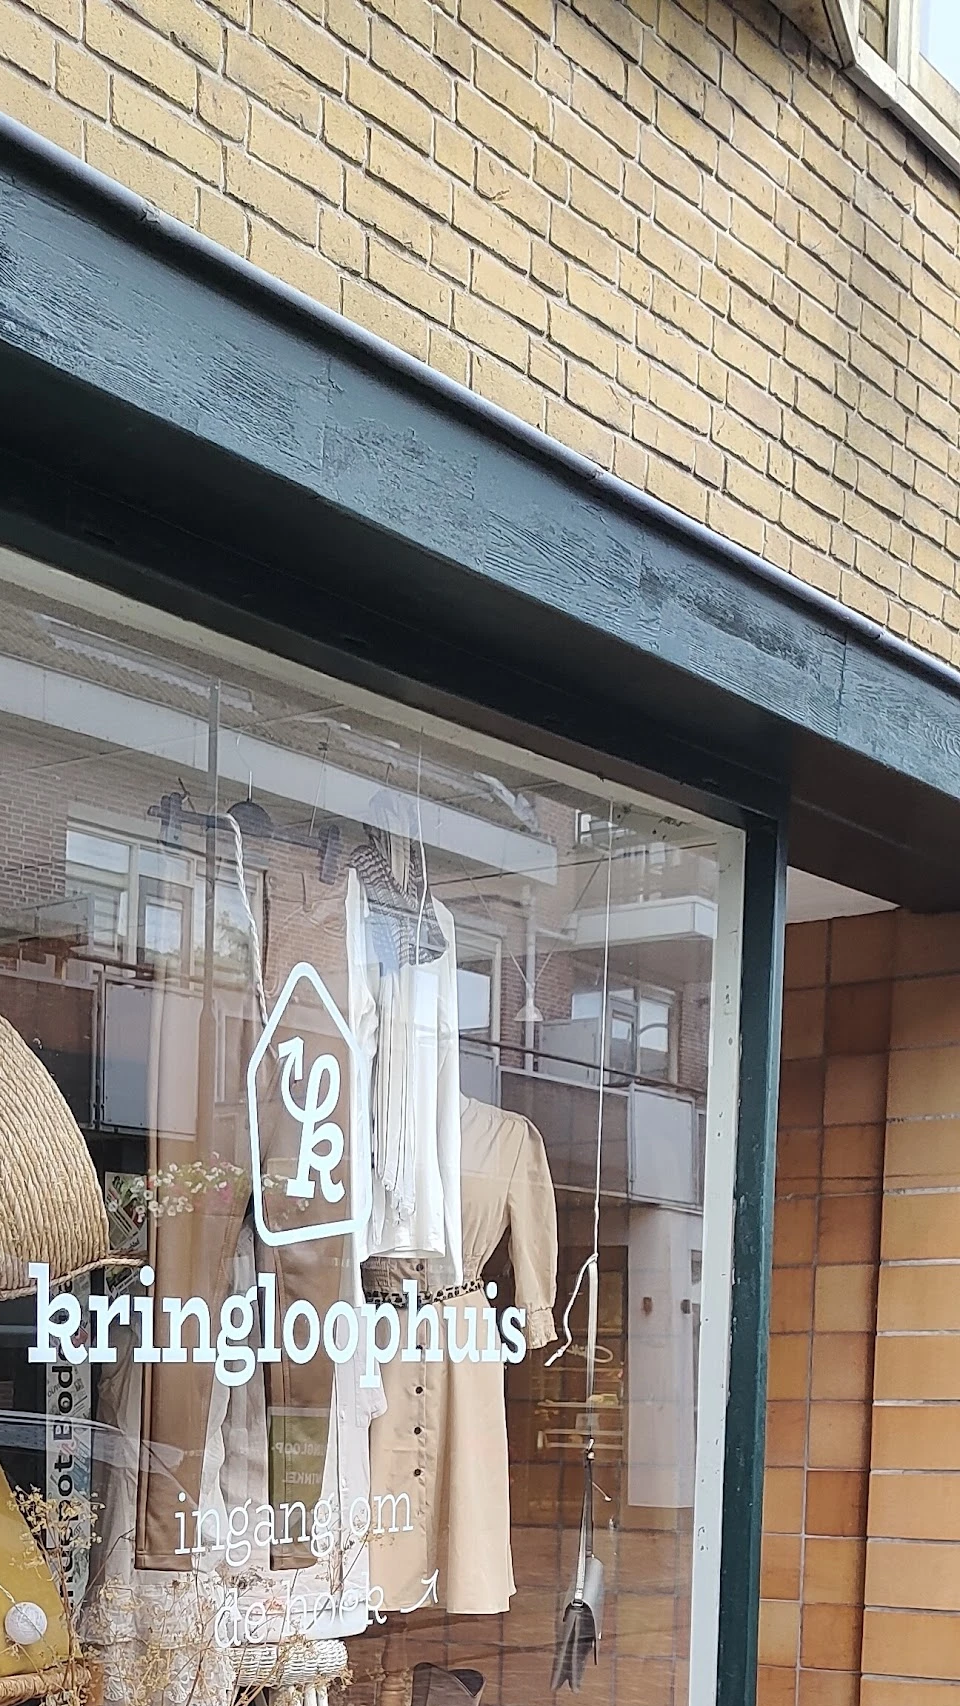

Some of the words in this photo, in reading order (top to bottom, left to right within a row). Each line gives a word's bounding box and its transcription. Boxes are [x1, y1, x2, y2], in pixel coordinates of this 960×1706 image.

[28, 1261, 527, 1388] kringloophuis
[174, 1492, 335, 1567] ingang
[349, 1490, 414, 1537] om
[214, 1588, 266, 1648] de
